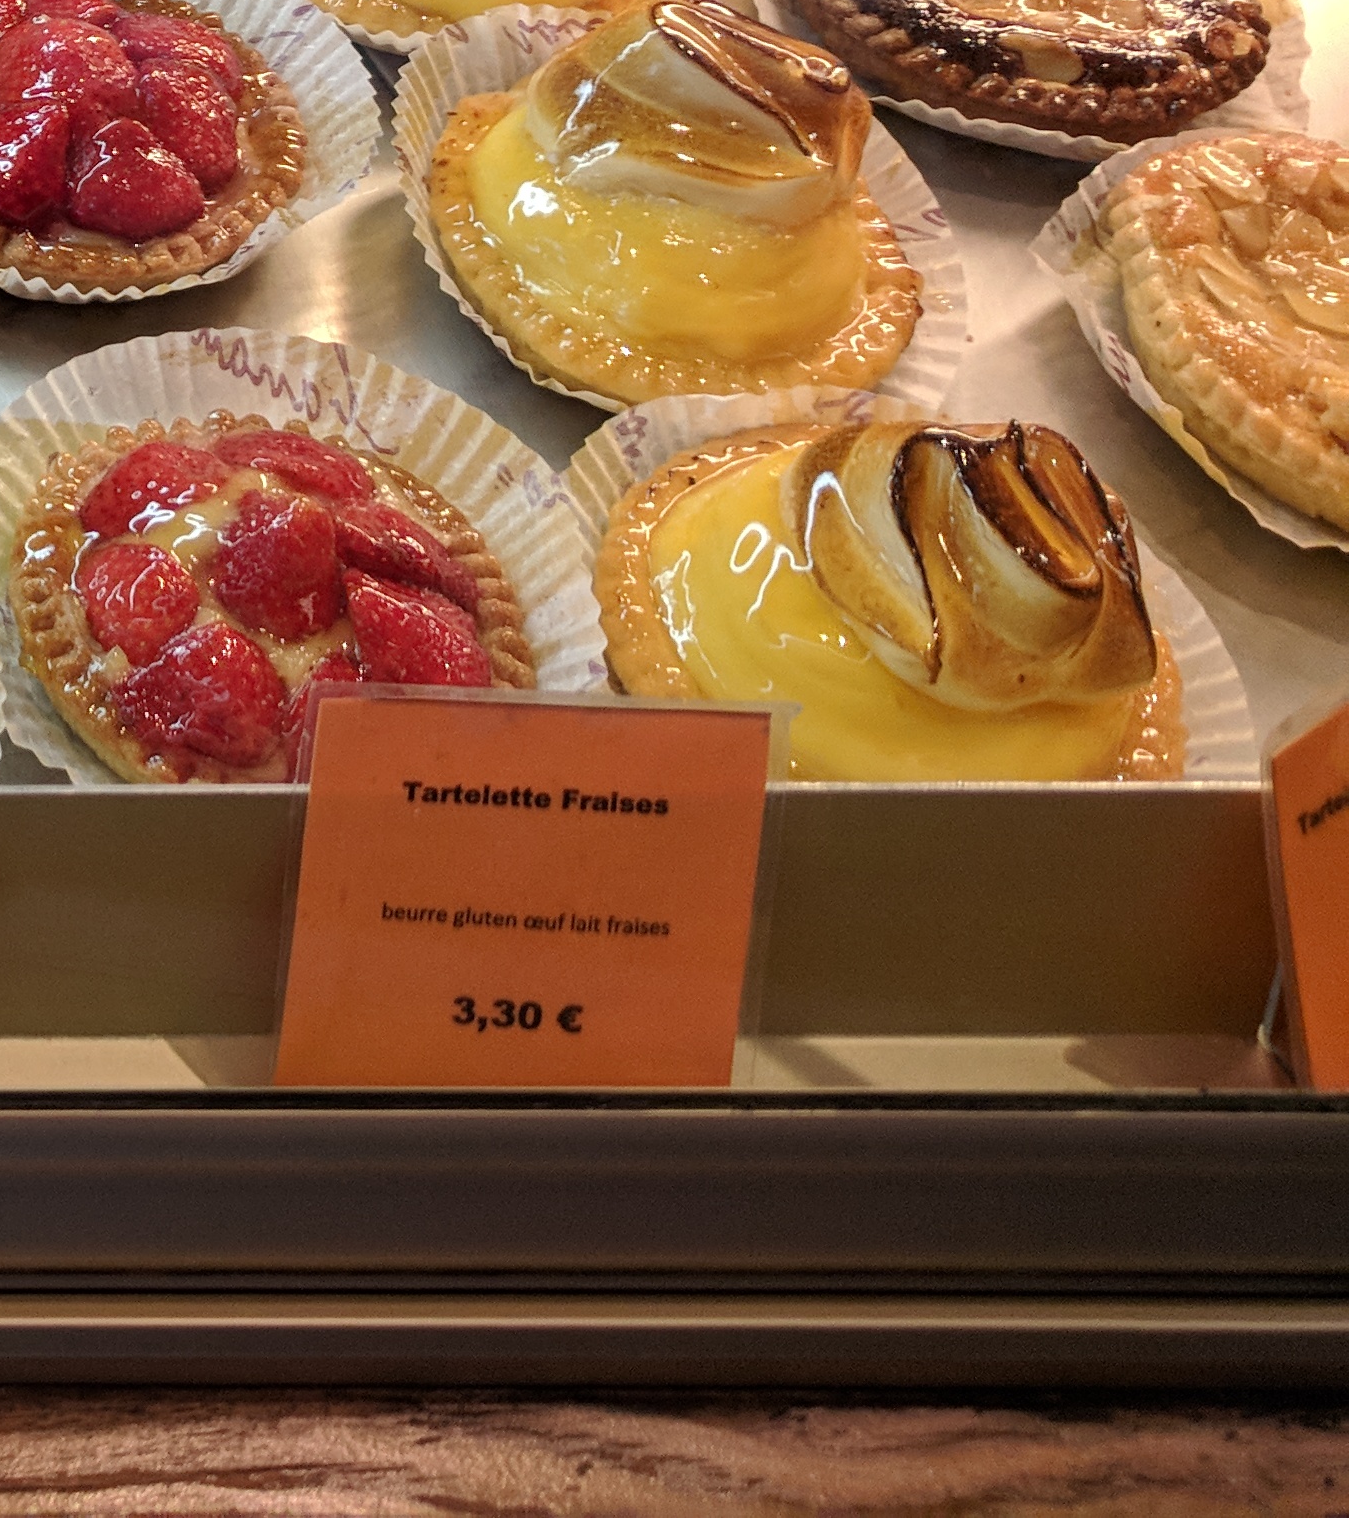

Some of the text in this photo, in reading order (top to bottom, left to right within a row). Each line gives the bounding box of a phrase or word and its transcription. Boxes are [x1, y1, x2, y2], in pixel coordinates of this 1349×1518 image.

[402, 780, 670, 815] Tartelette Fraises
[381, 902, 671, 936] beurre gluten œuf lait fraises
[452, 996, 584, 1034] 3,30 €
